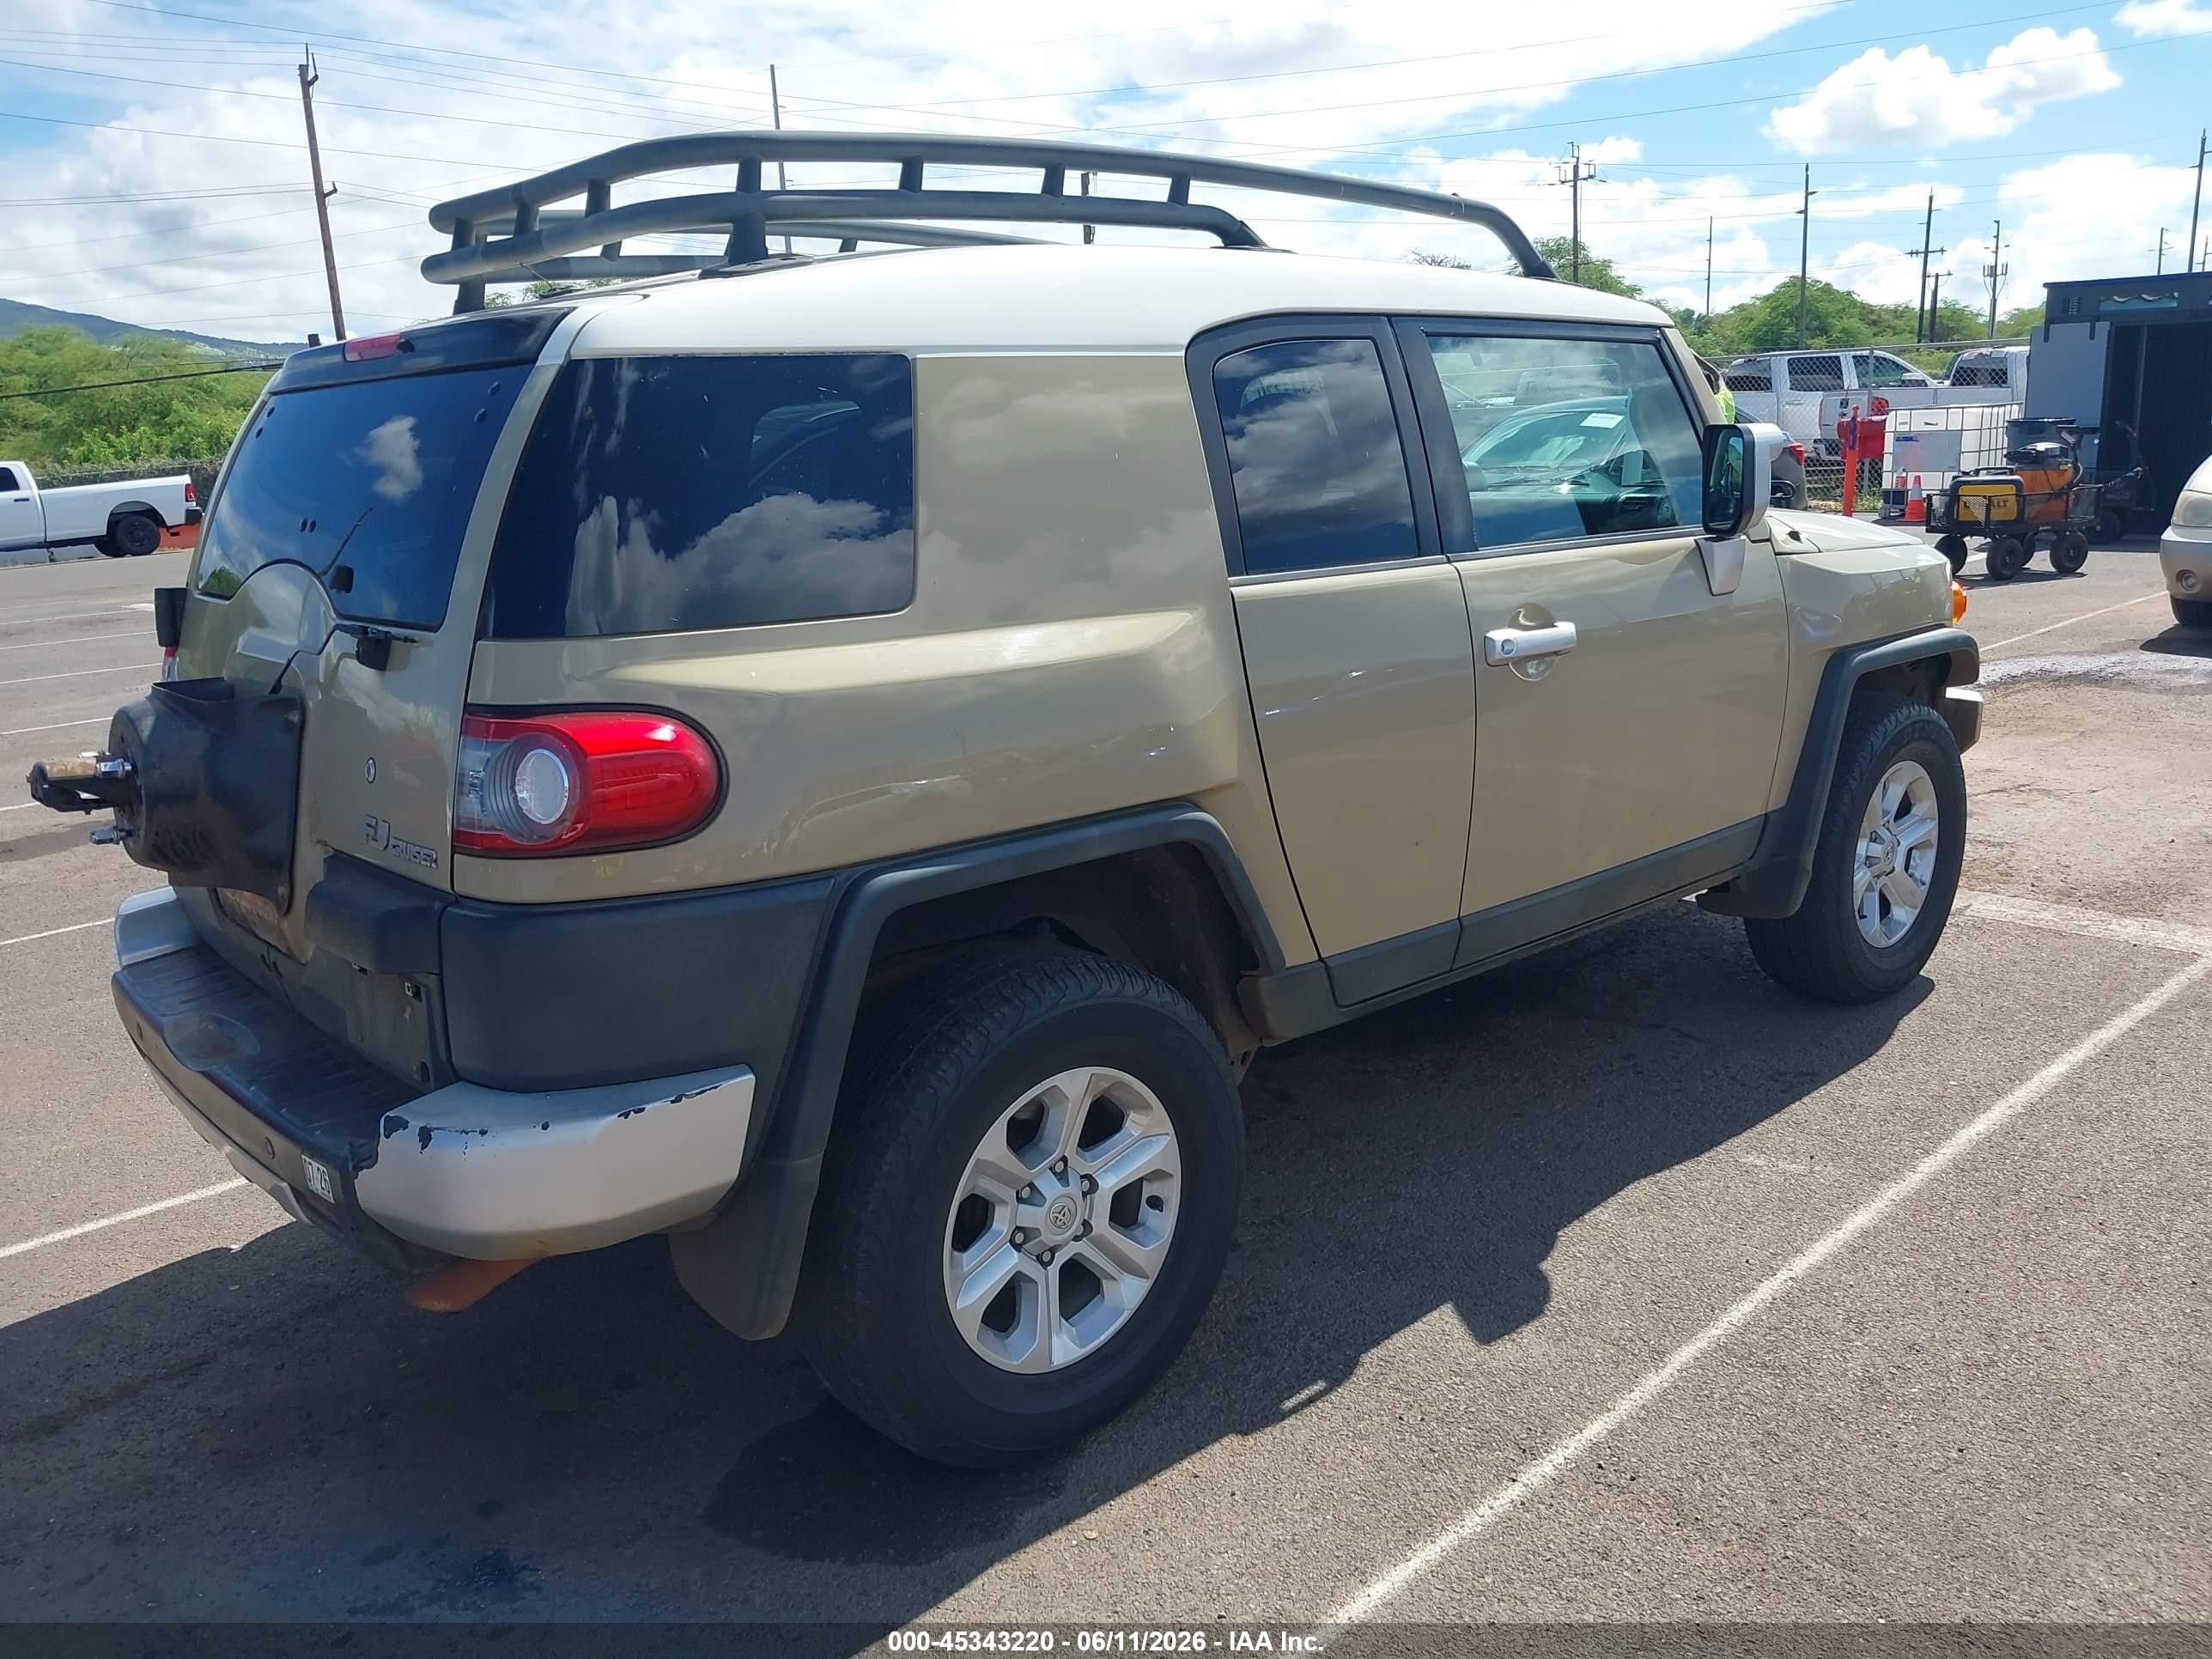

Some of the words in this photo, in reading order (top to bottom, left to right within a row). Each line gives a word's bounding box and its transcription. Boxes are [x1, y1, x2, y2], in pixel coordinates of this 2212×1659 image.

[362, 814, 391, 851] FJ
[390, 832, 439, 868] CRUISER
[317, 1166, 331, 1194] 26
